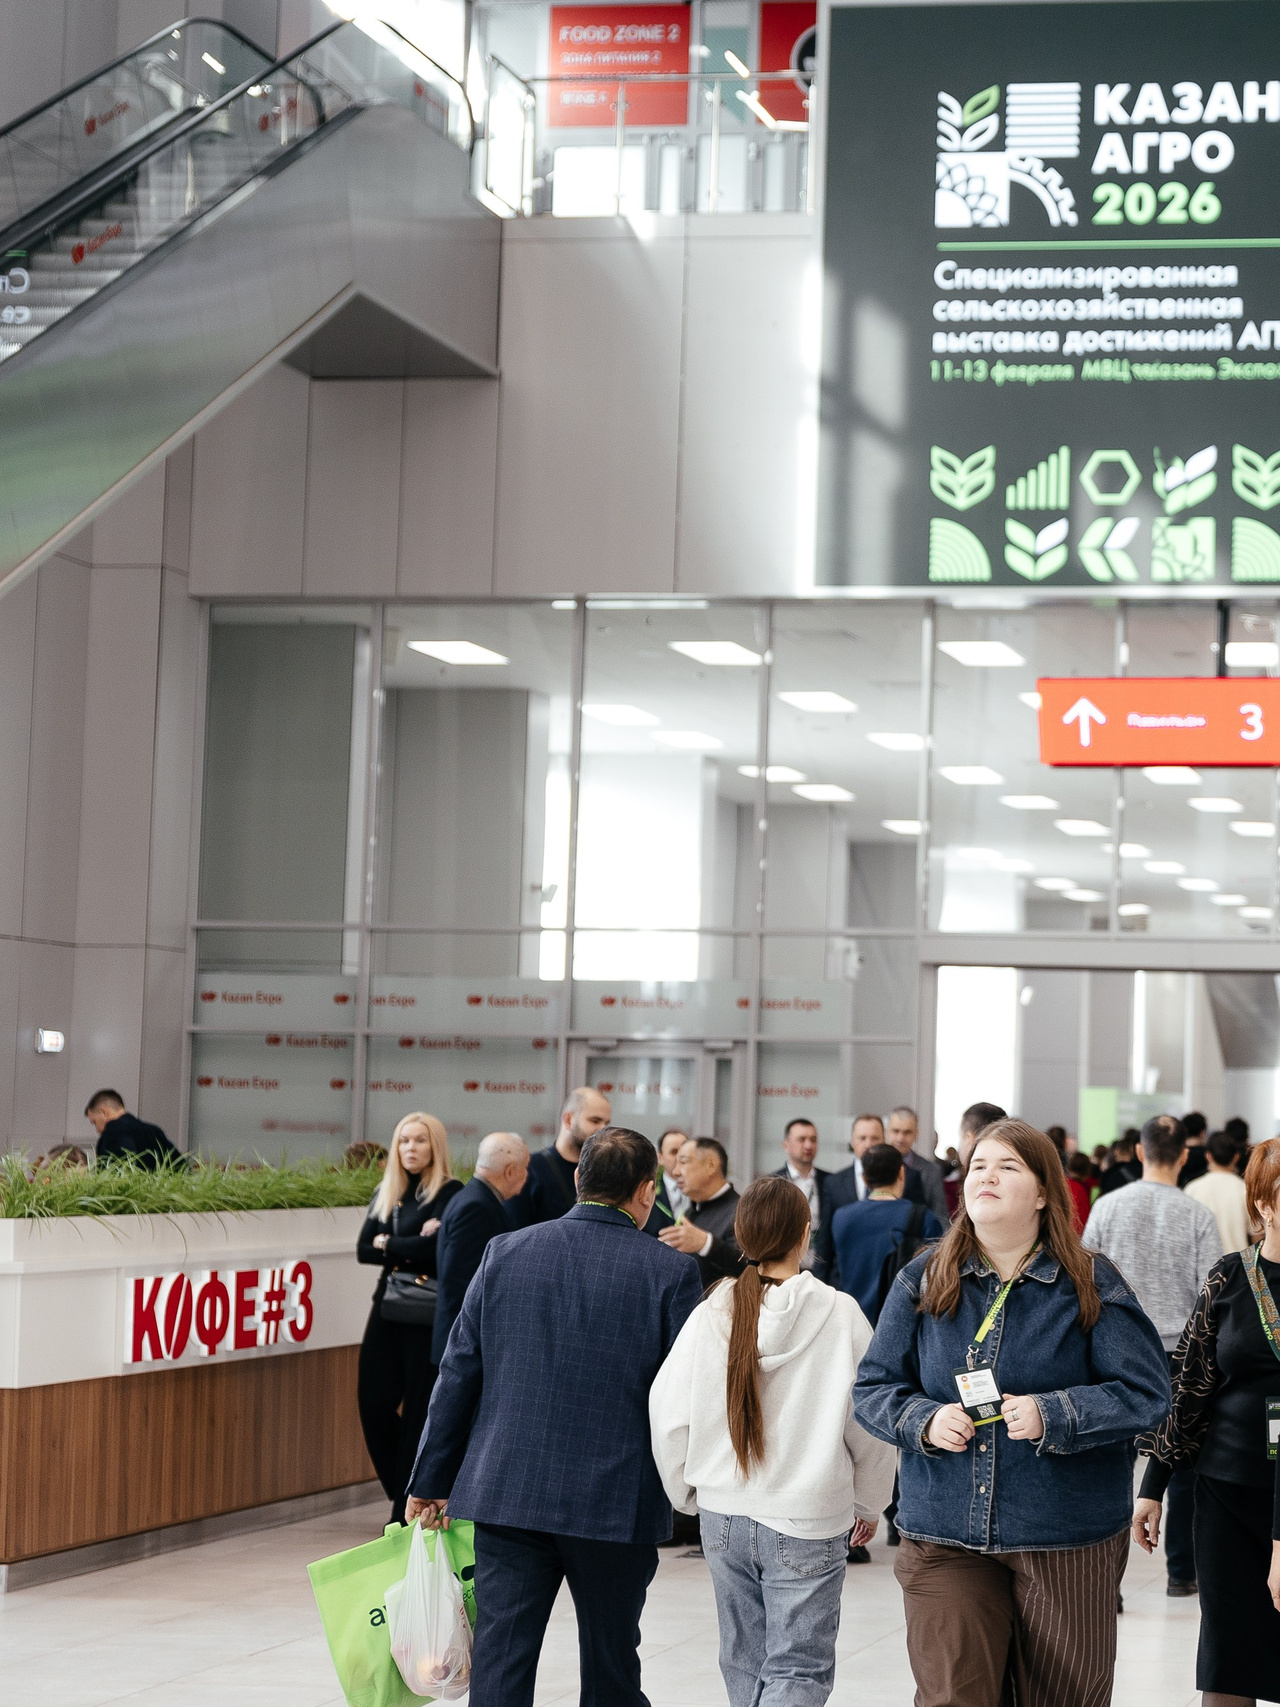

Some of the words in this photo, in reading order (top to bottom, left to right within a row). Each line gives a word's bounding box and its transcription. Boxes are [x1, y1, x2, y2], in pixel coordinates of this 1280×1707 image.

[559, 26, 612, 44] FOOD
[614, 25, 665, 43] ZONE
[667, 24, 681, 43] 2
[1091, 130, 1234, 174] АГРО
[1091, 181, 1222, 225] 2026
[934, 259, 1239, 293] Специализированная
[932, 291, 1244, 321] сельскохозяйственная
[932, 330, 1060, 353] выставка
[1062, 323, 1233, 356] достижений
[930, 359, 988, 382] 11-13
[990, 359, 1075, 386] февраля
[1239, 703, 1264, 741] 3
[221, 990, 252, 1005] Kazan
[256, 990, 283, 1006] Expo
[217, 1076, 249, 1090] Kazan
[252, 1076, 279, 1091] Expo
[130, 1260, 313, 1363] КОФЕ#3
